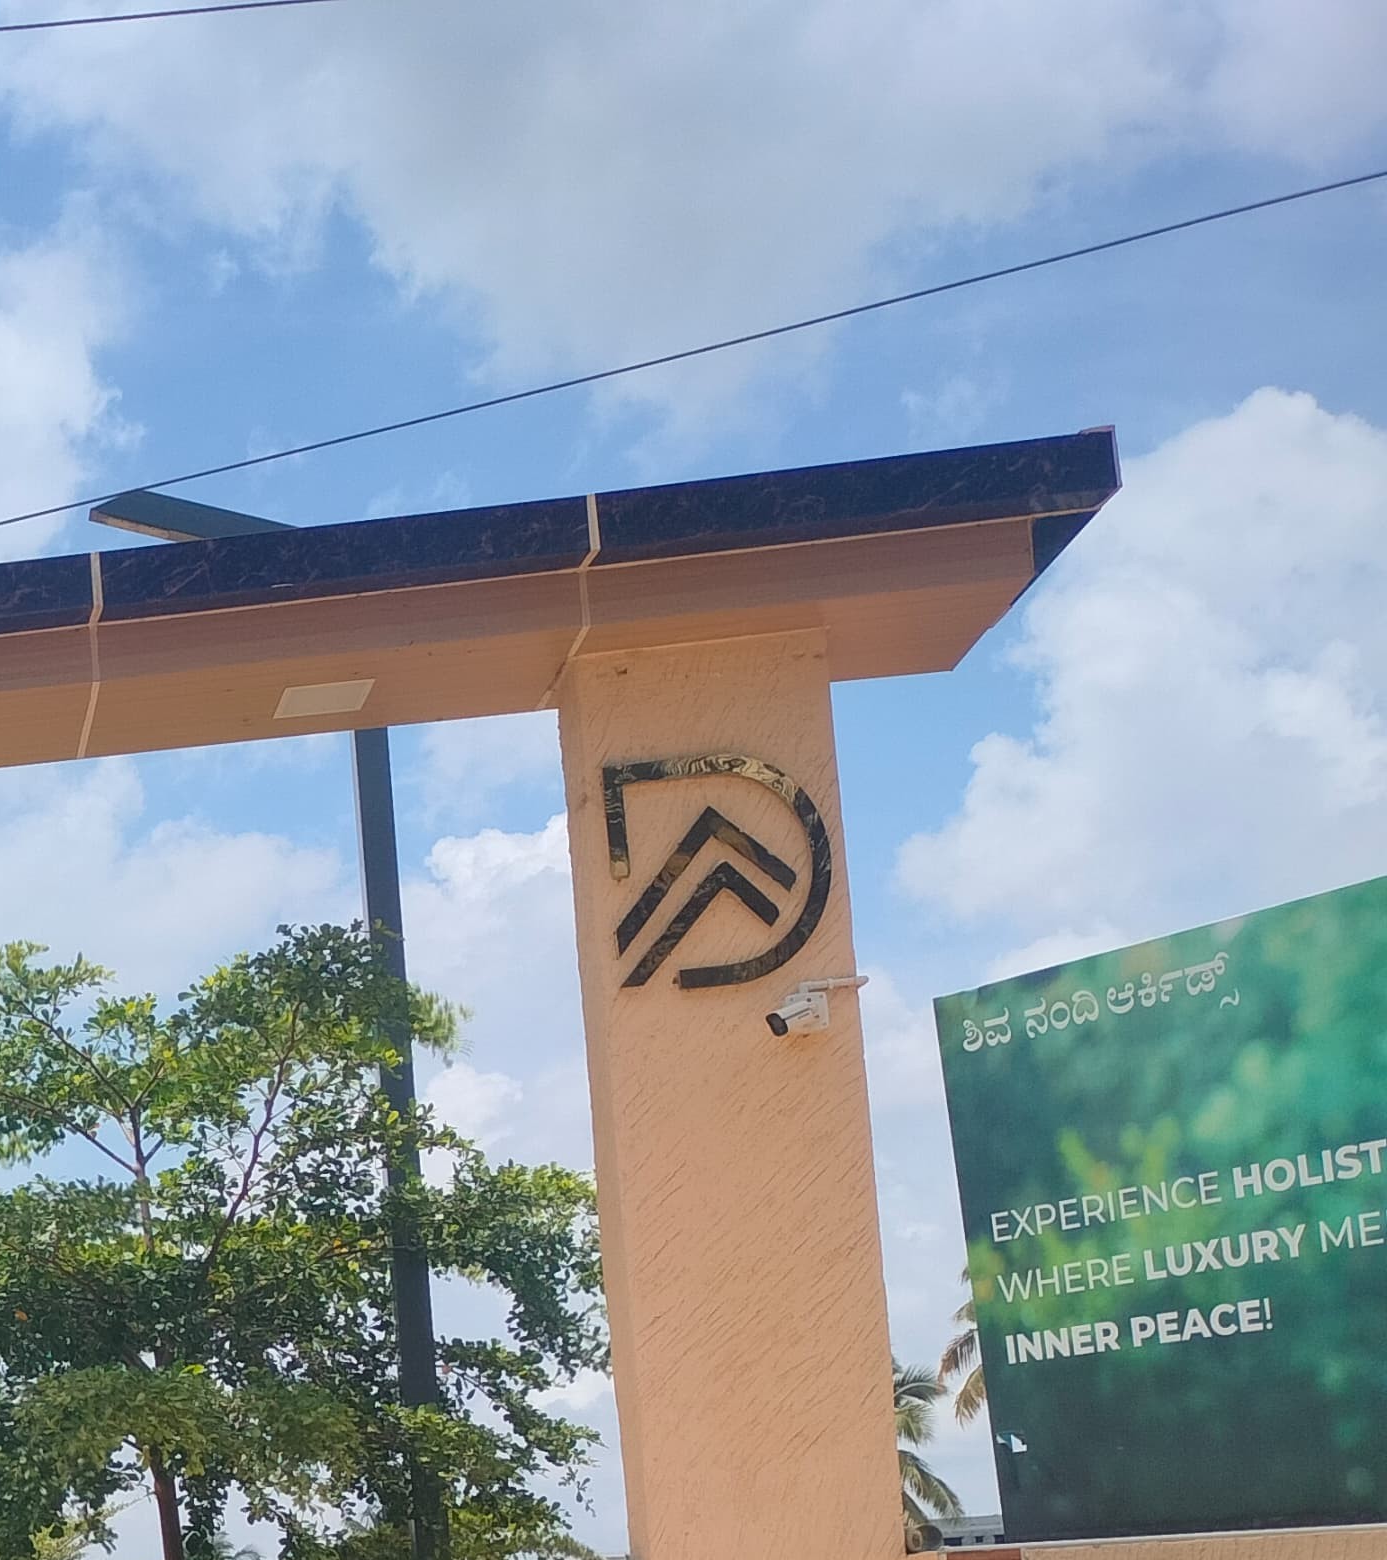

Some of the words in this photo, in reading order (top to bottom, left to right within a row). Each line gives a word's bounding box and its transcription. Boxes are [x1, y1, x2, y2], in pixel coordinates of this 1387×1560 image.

[962, 1008, 1013, 1052] ಶಿವ
[1024, 990, 1099, 1039] ನಂದಿ
[990, 1171, 1222, 1243] EXPERIENCE
[1232, 1138, 1387, 1199] HOLIST
[997, 1253, 1134, 1303] WHERE
[1143, 1223, 1306, 1281] LUXURY
[1318, 1209, 1387, 1253] ME
[1005, 1321, 1120, 1365] INNER
[1130, 1297, 1274, 1348] PEACE!
